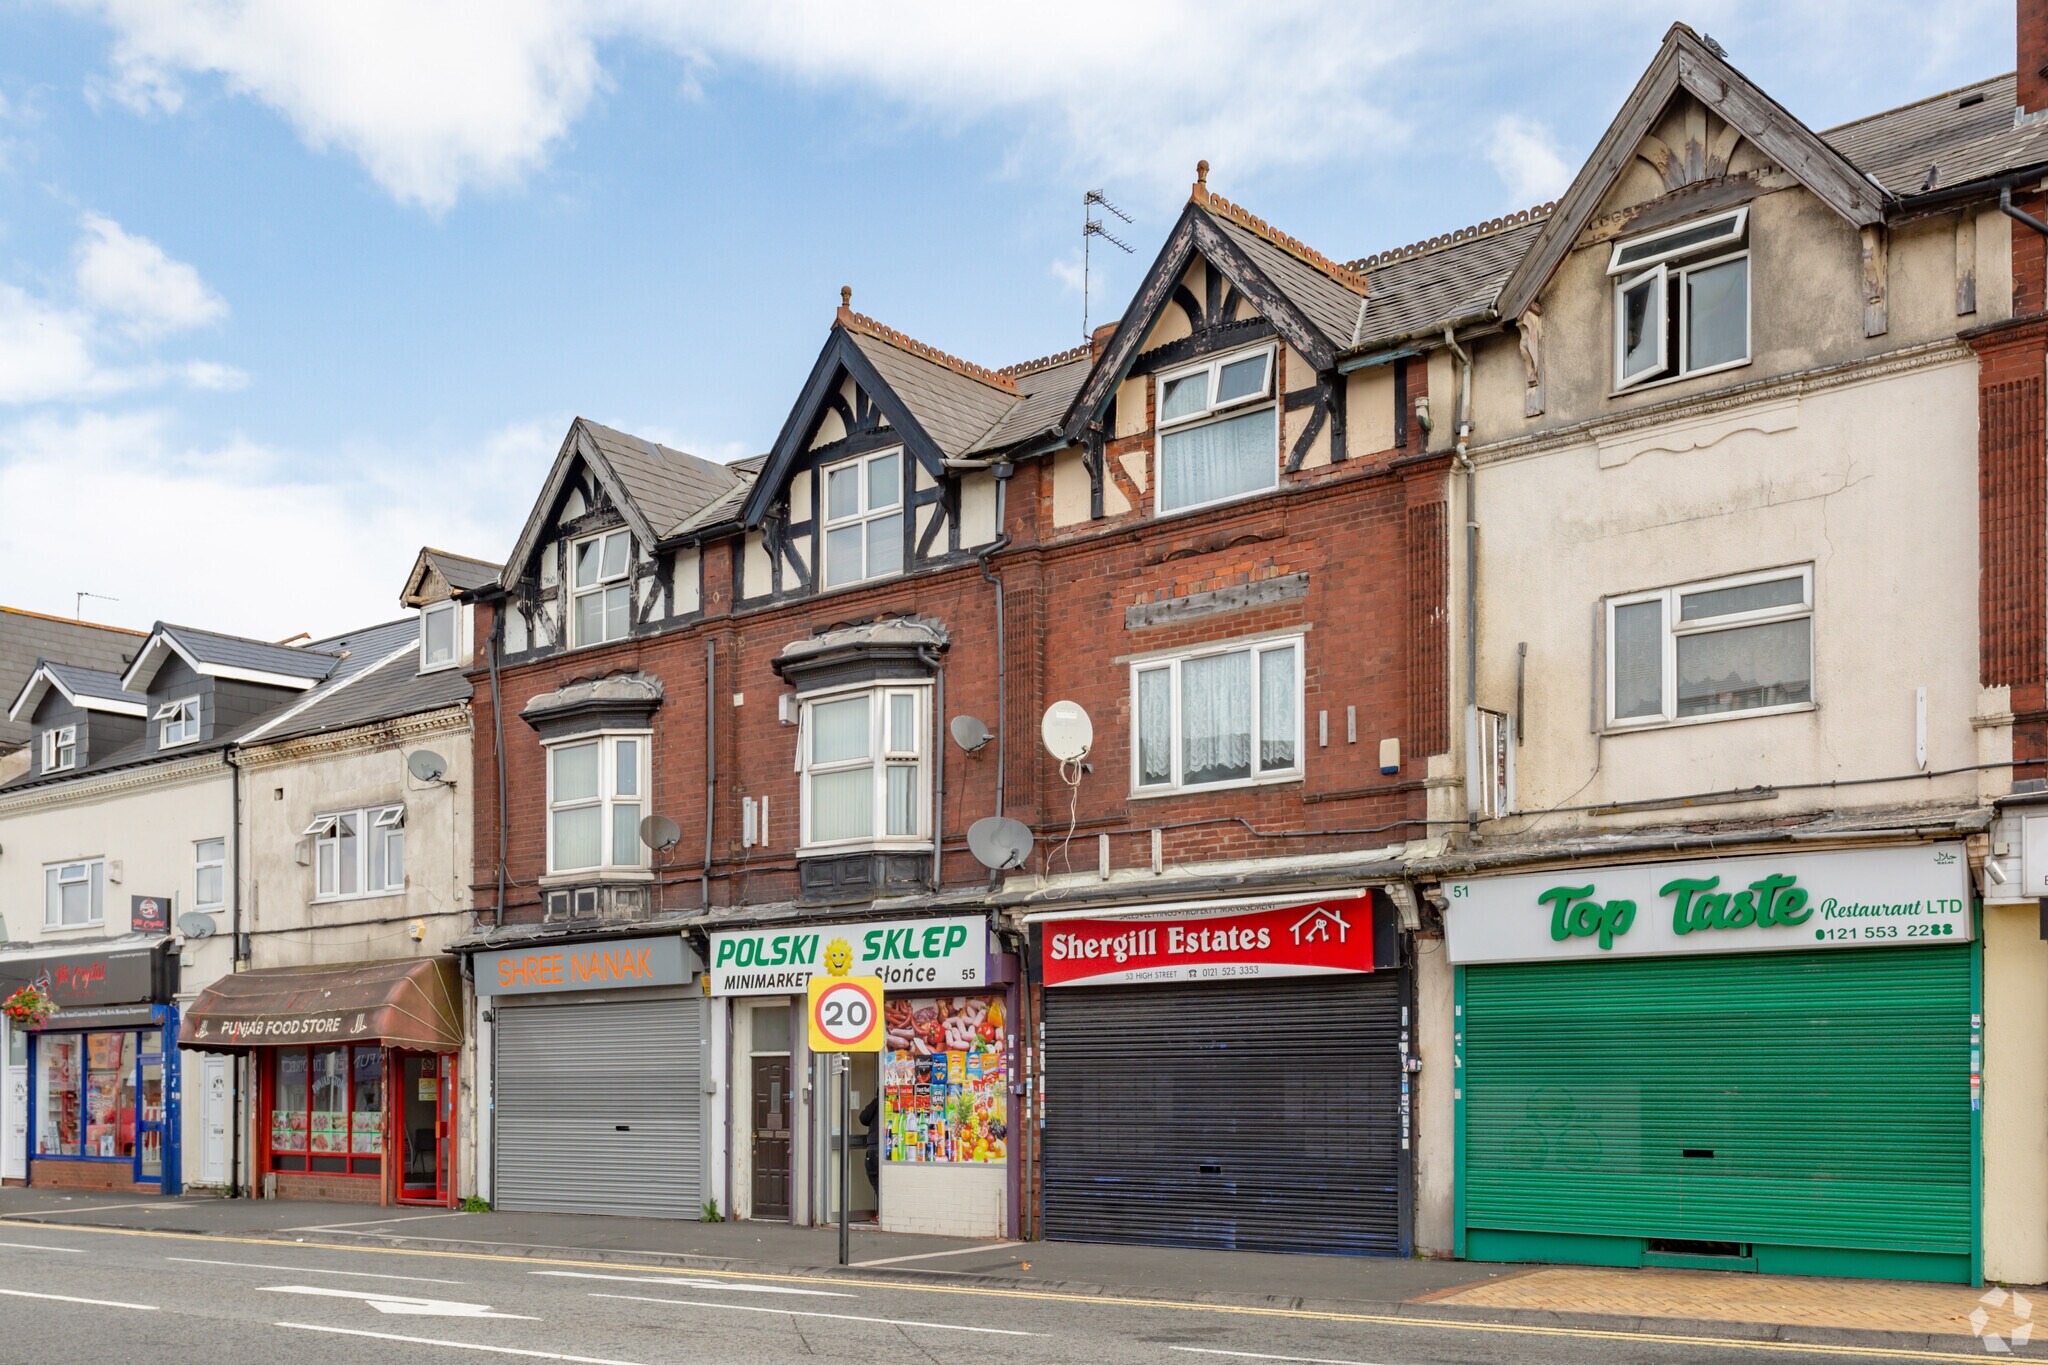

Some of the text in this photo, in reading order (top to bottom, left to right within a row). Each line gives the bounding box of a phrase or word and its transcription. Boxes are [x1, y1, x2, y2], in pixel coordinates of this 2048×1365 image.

[1453, 885, 1469, 899] 51
[1538, 874, 1815, 950] Top Taste
[1820, 898, 1962, 920] Restaurant LTD
[1815, 923, 1953, 941] 0121 553 2288
[716, 925, 967, 969] POLSKI SKLEP
[1051, 926, 1271, 963] Shergill Estates
[498, 947, 653, 987] SHREE NANAK
[1125, 965, 1259, 981] 53 HIGH STREET 0121 525 3353
[724, 972, 813, 990] MINIMARKET
[962, 968, 976, 980] 55
[825, 1001, 867, 1026] 20
[221, 1018, 341, 1037] PUNJAB FOOD STORE
